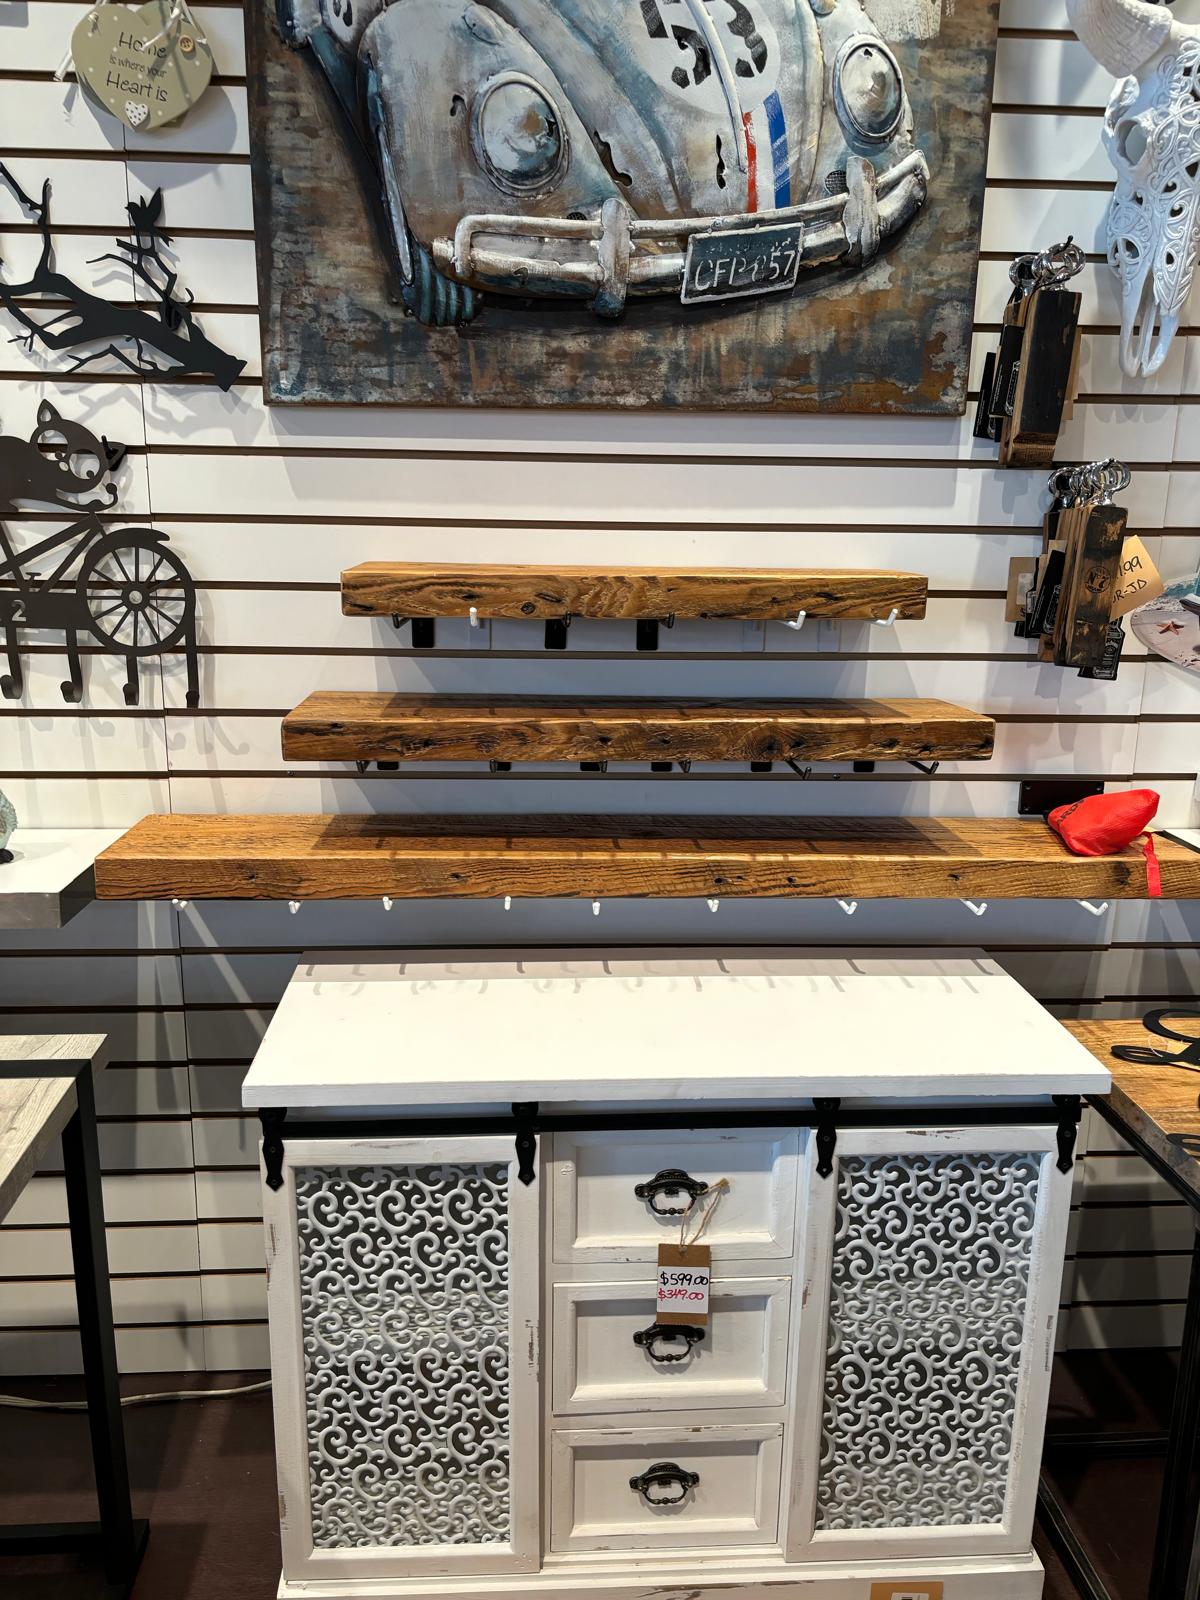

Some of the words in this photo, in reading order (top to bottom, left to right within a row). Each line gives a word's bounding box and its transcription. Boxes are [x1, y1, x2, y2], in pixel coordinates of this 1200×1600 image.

[109, 54, 117, 65] is
[118, 57, 145, 73] where
[147, 66, 167, 79] your
[106, 70, 153, 98] Heart
[156, 86, 168, 102] is
[660, 1270, 709, 1286] $599.00
[657, 1287, 704, 1301] $349.00
